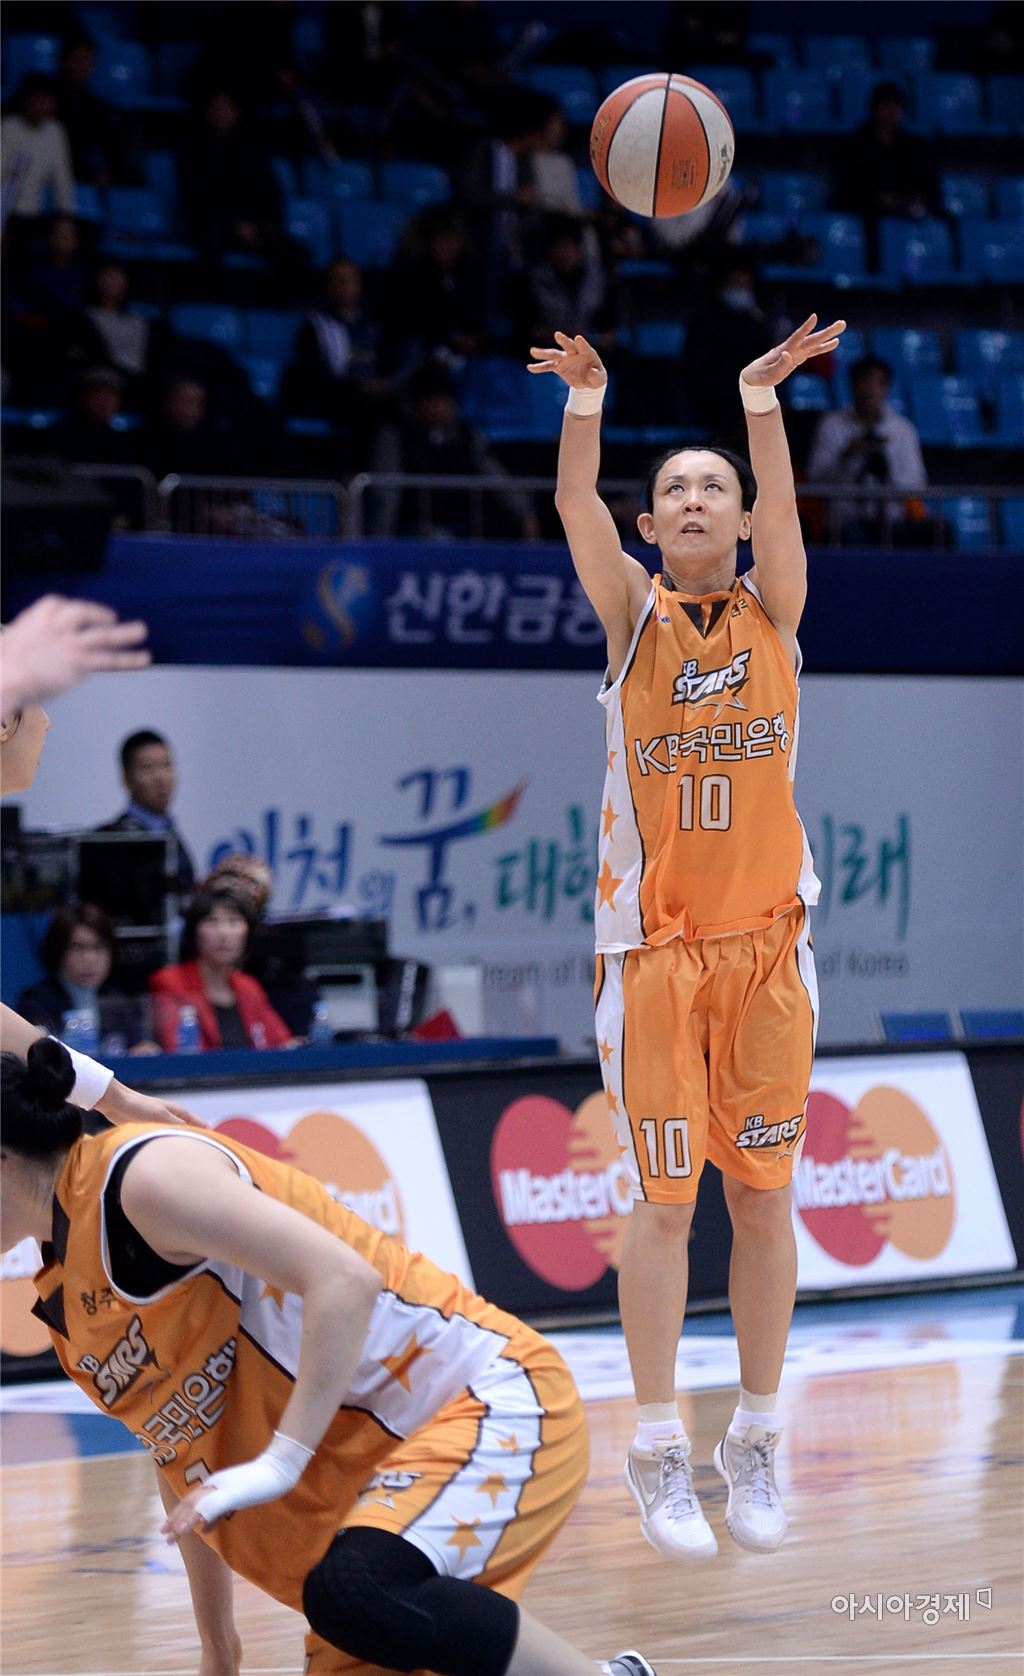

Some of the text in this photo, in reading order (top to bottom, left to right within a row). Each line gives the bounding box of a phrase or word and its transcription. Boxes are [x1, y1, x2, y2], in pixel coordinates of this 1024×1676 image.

[671, 647, 752, 706] STARS
[676, 773, 732, 832] 10
[638, 1117, 693, 1179] 10
[734, 1113, 804, 1149] STARS
[744, 1114, 765, 1130] KB
[793, 1150, 950, 1210] MasterCard
